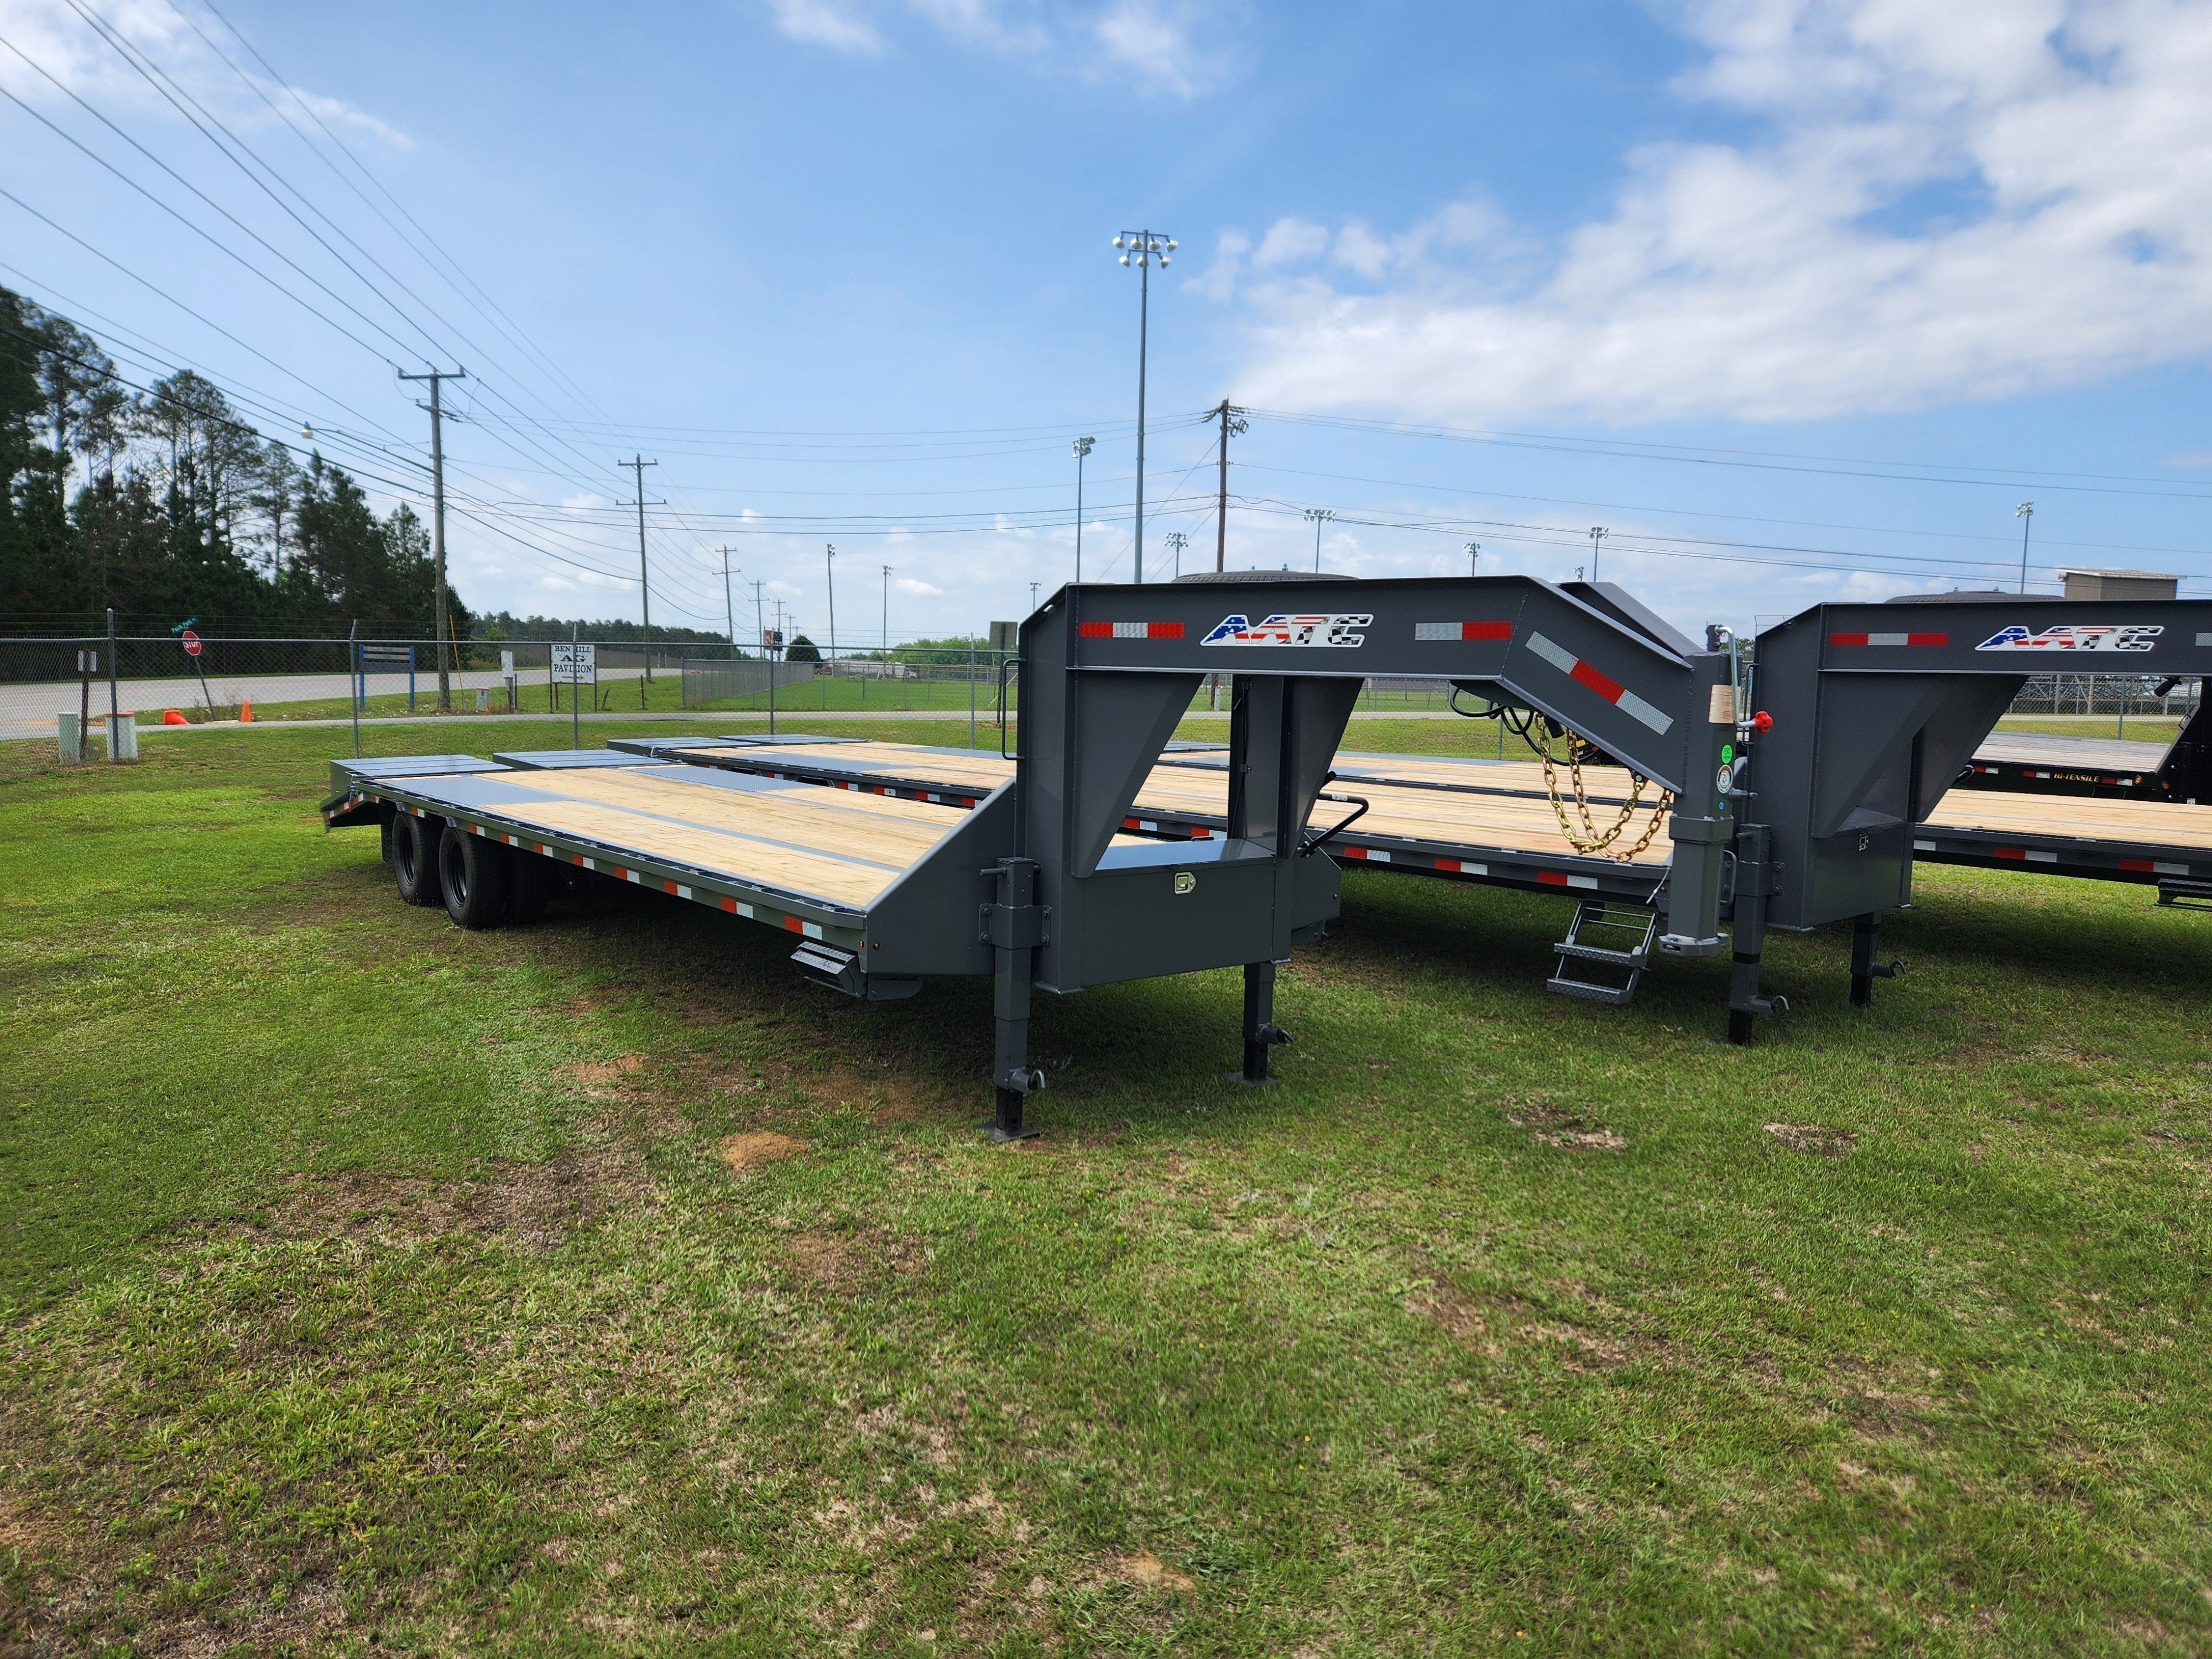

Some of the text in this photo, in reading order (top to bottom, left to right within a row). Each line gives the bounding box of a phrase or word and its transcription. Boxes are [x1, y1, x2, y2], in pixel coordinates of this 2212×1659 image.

[1203, 616, 1373, 645] AATC
[1981, 627, 2163, 650] AATC
[554, 664, 592, 673] PAVIION
[2054, 773, 2099, 782] HI-TENSILE
